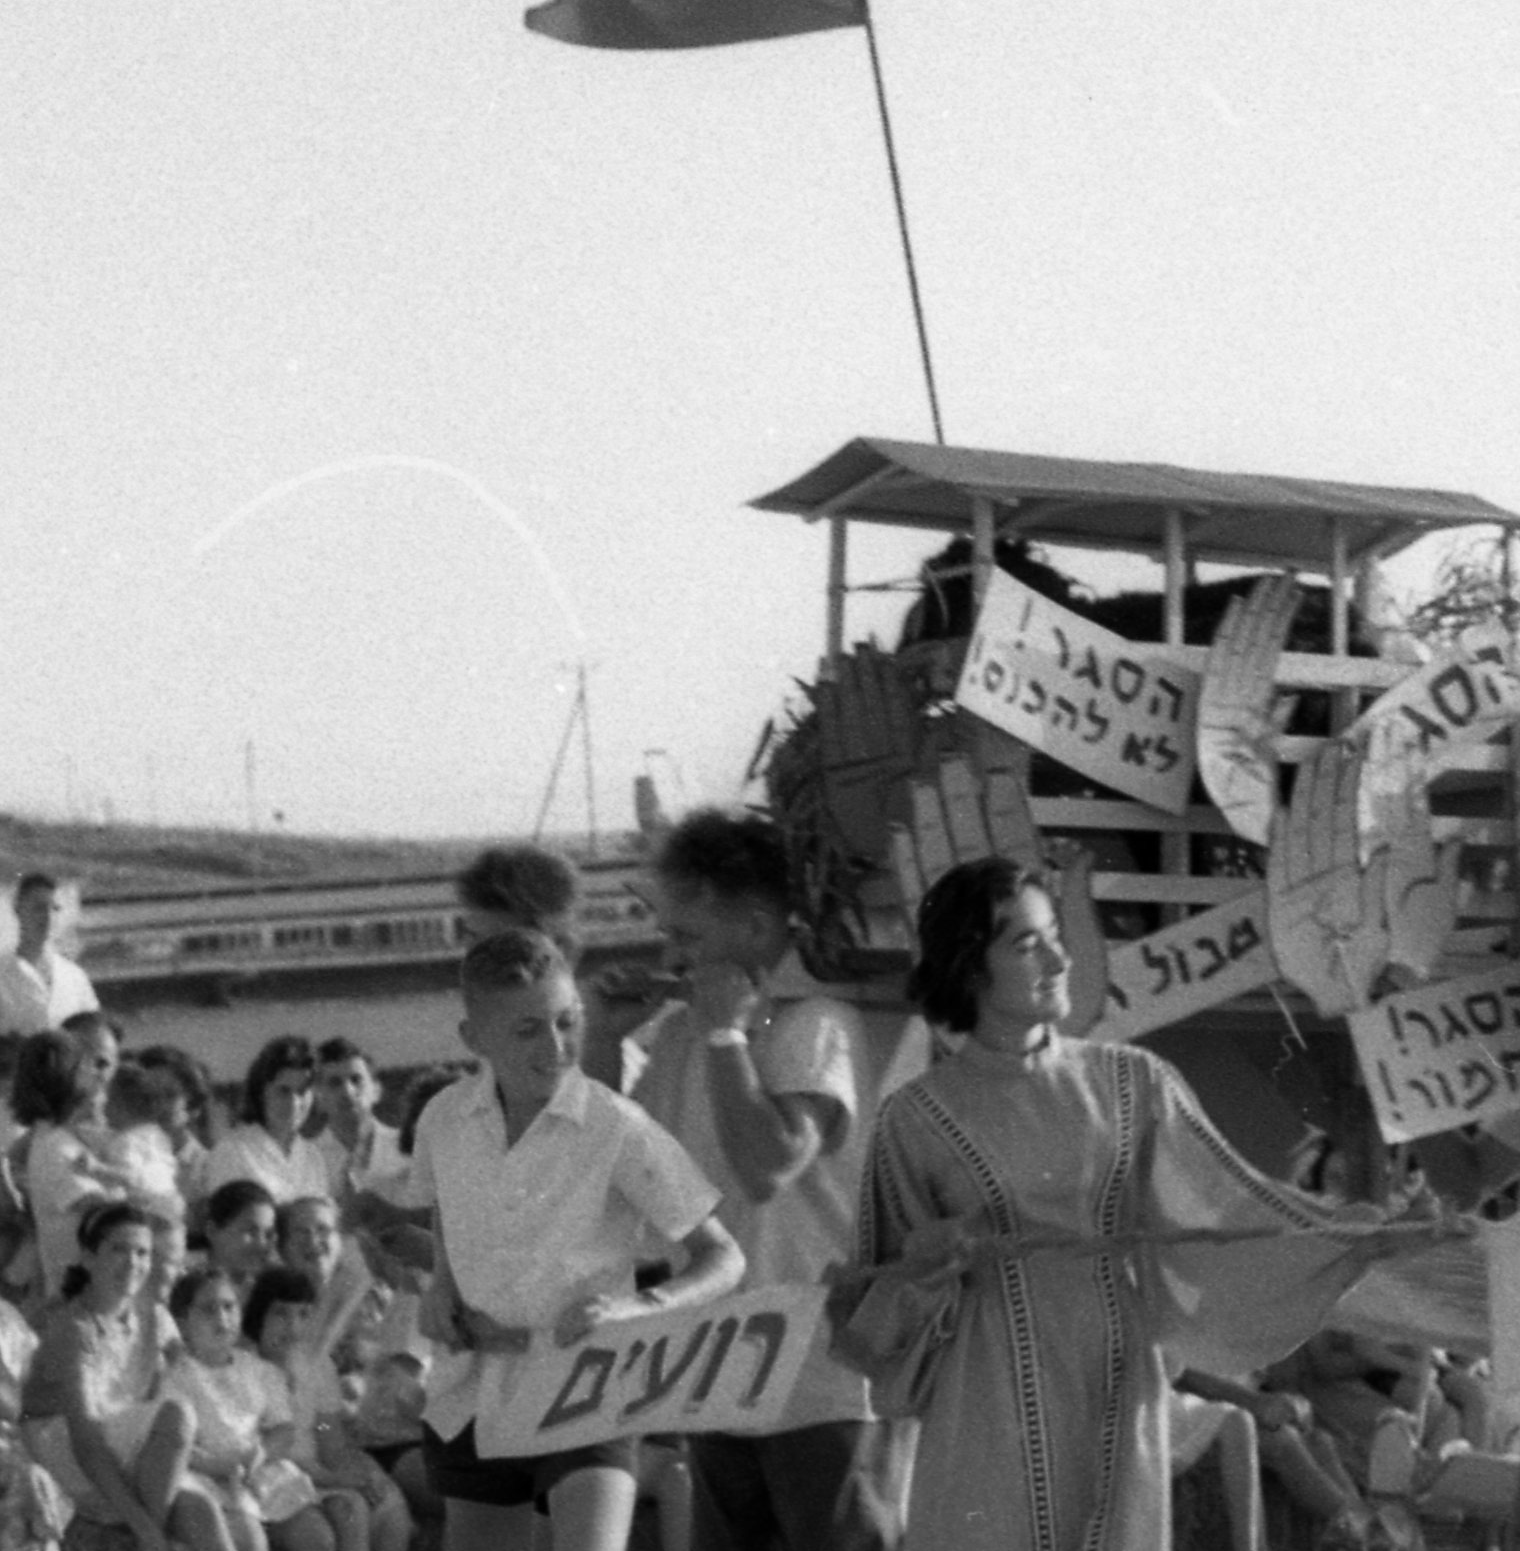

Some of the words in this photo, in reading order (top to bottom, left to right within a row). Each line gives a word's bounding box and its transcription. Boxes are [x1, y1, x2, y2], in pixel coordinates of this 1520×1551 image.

[1121, 733, 1179, 773] לא
[1399, 645, 1504, 754] הסג
[536, 1311, 787, 1432] רועים
